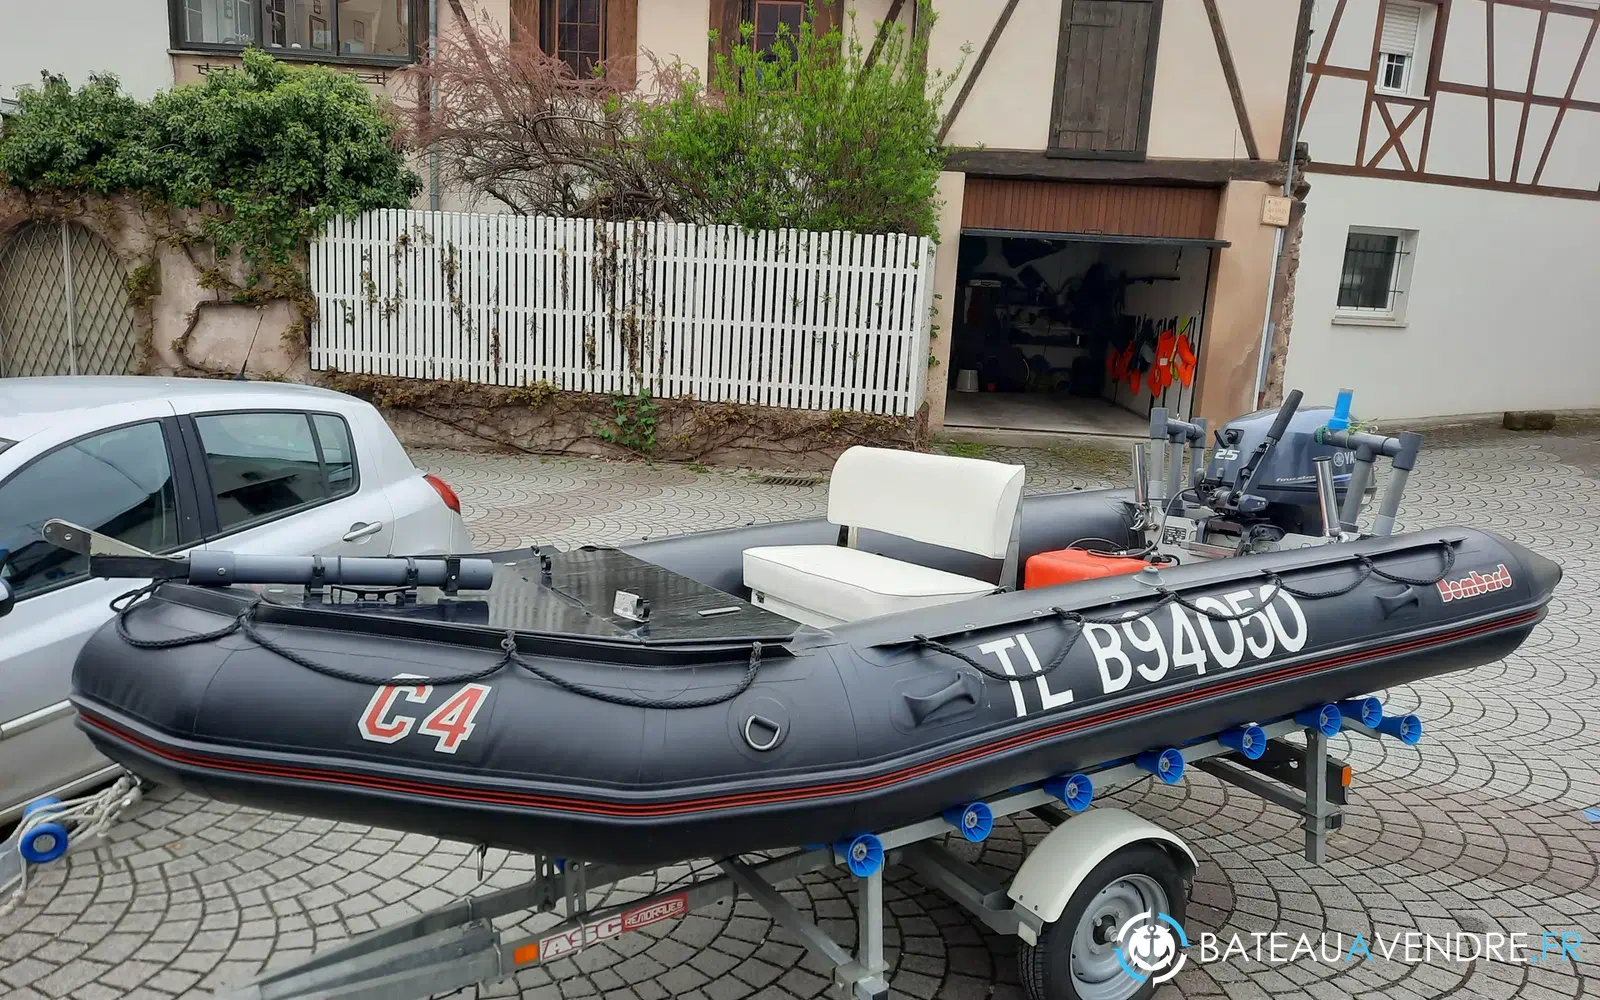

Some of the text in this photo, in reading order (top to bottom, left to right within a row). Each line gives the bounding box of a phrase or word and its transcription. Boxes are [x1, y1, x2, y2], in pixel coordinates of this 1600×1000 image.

[1214, 448, 1240, 460] 25
[977, 584, 1307, 717] TL B94050
[357, 673, 492, 754] C4
[541, 901, 684, 960] ASC REMORQUES
